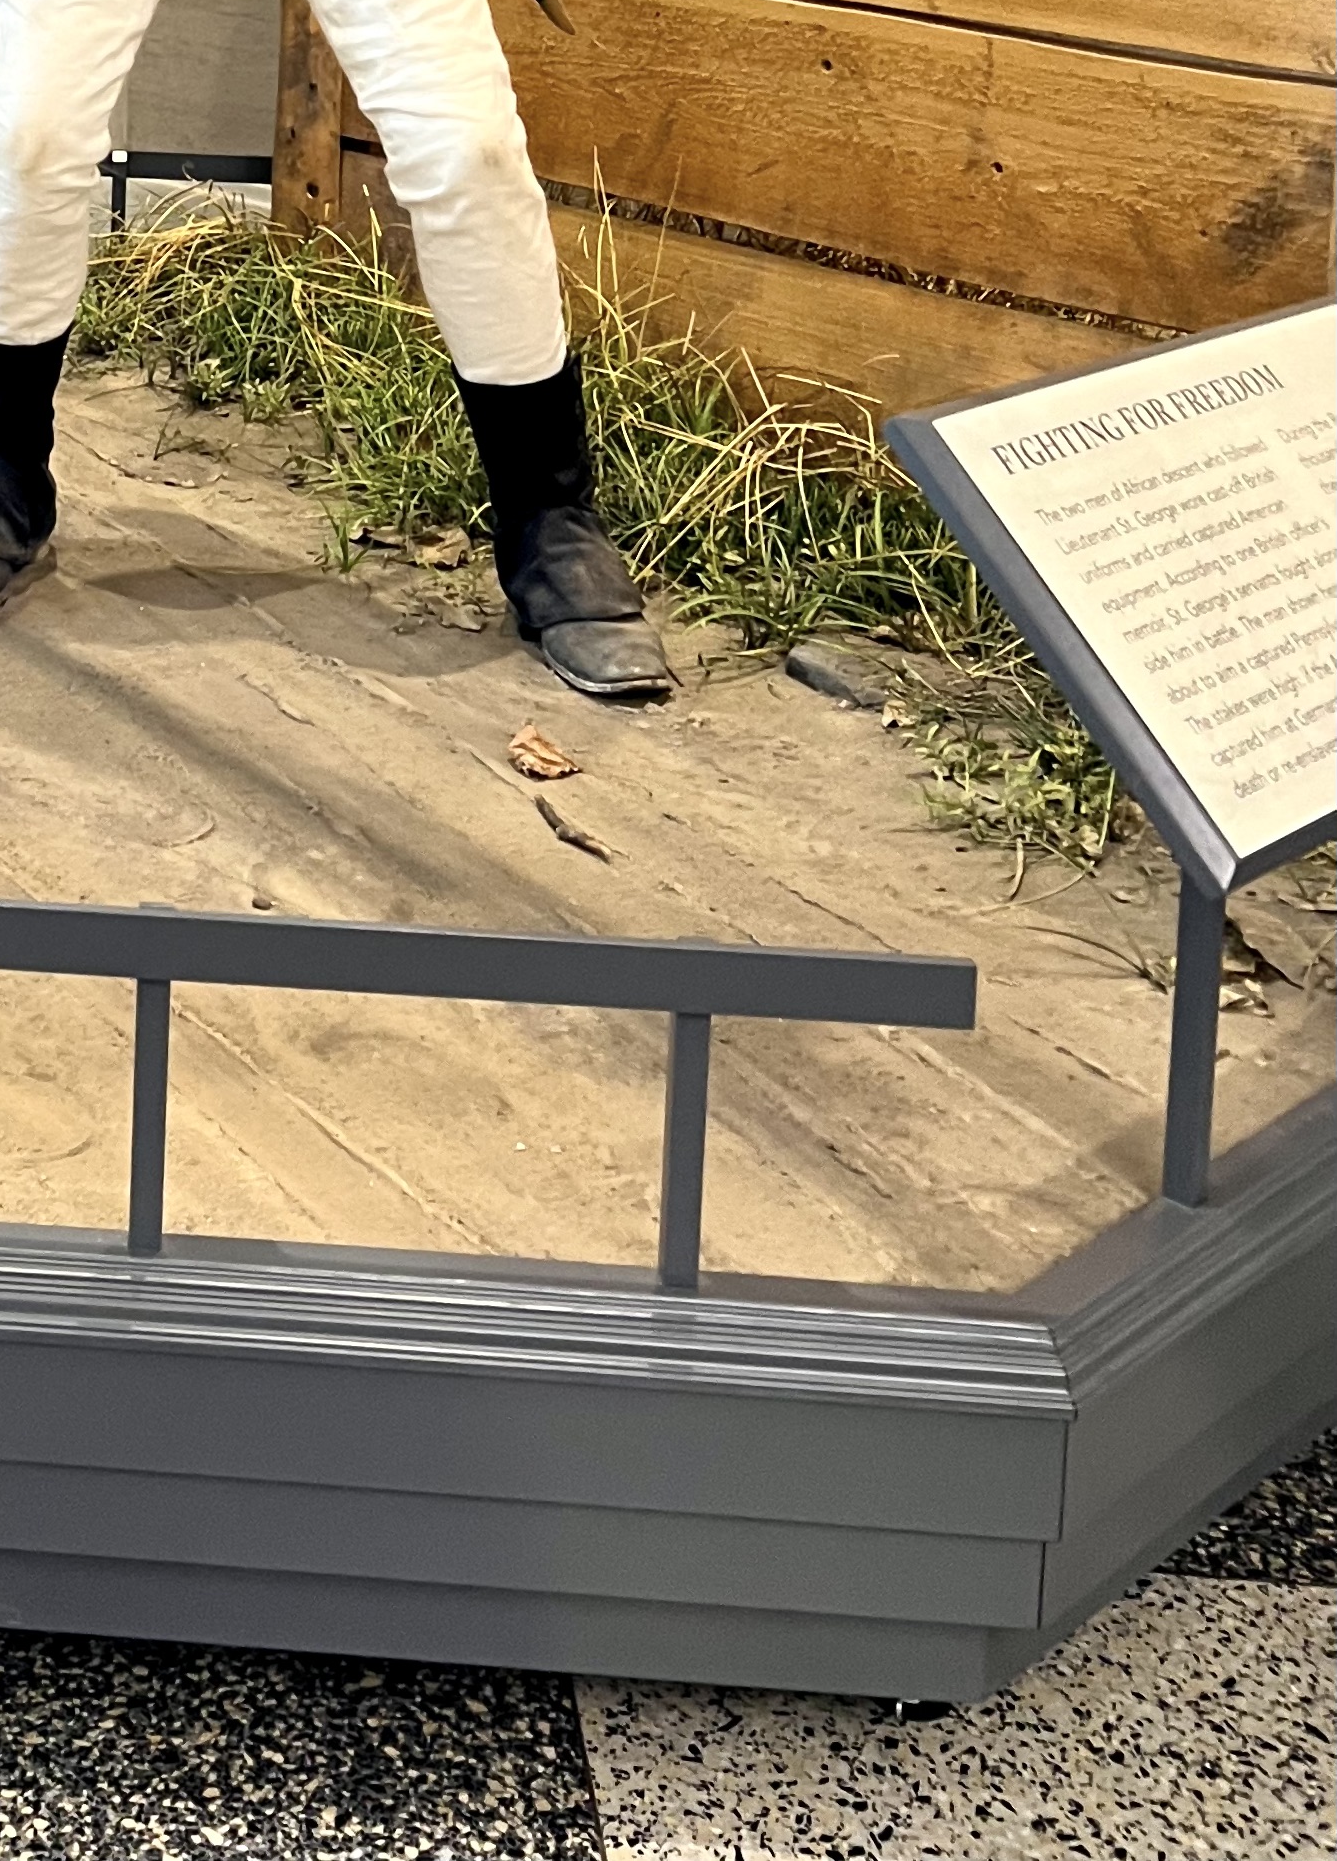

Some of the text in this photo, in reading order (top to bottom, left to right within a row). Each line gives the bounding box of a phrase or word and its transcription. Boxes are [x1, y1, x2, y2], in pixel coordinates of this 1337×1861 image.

[990, 364, 1285, 476] FIGHTING FOR FREEDOM
